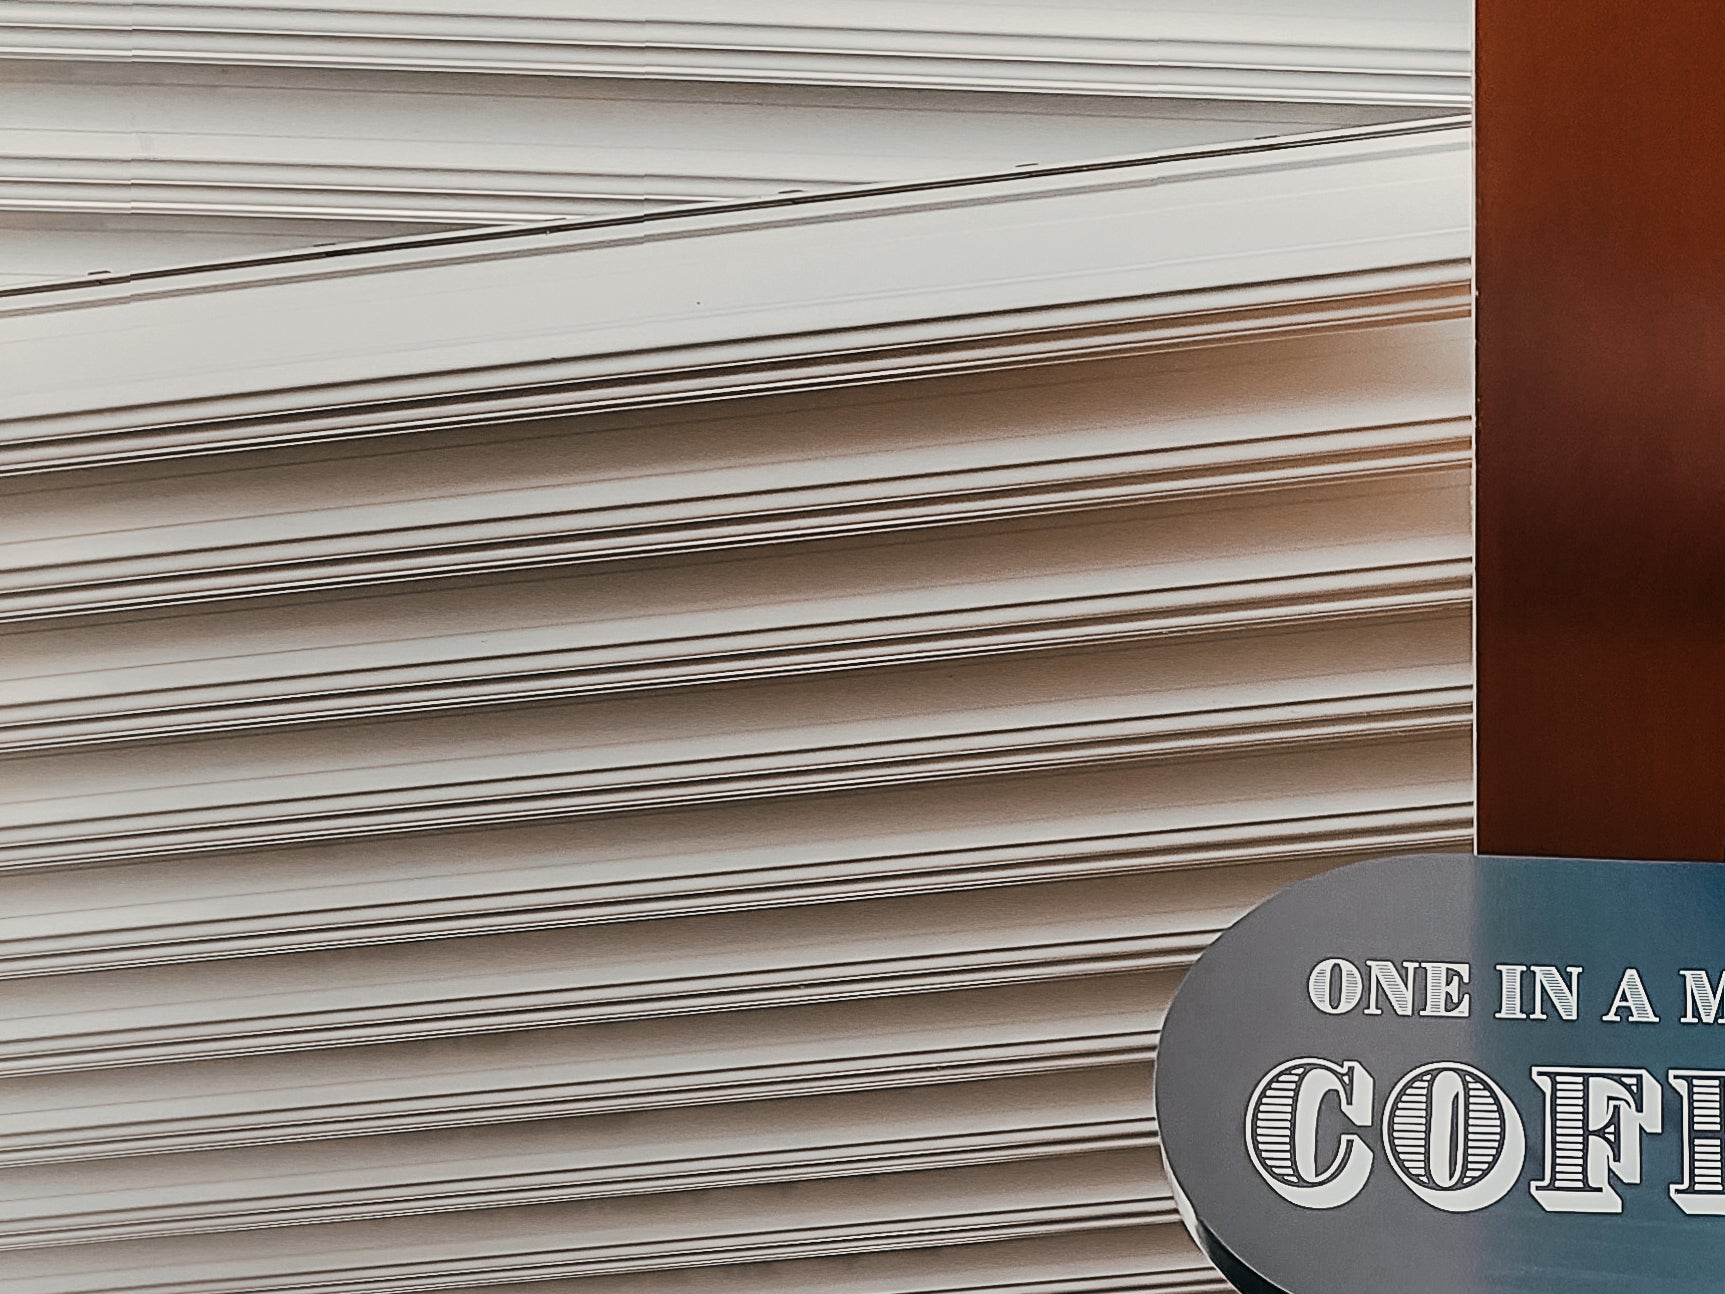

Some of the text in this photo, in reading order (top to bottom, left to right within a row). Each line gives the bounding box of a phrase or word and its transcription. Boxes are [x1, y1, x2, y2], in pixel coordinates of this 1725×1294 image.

[1308, 957, 1470, 1017] ONE
[1494, 964, 1583, 1020] IN
[1602, 968, 1660, 1023] A
